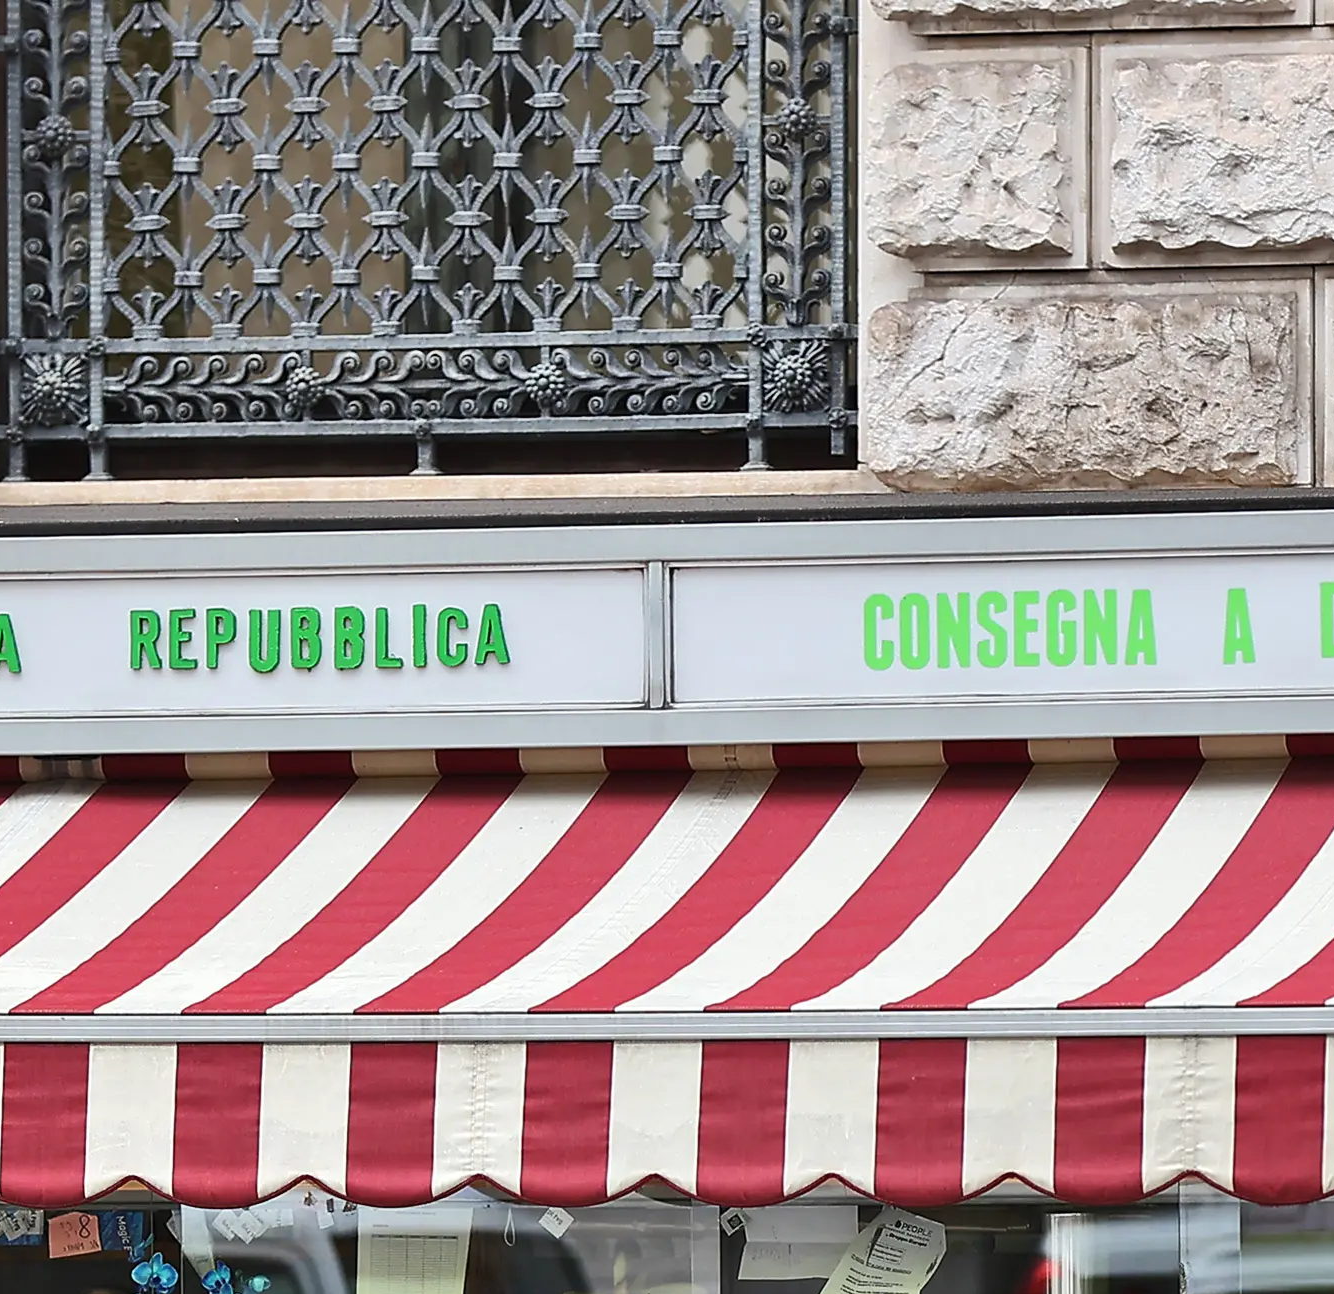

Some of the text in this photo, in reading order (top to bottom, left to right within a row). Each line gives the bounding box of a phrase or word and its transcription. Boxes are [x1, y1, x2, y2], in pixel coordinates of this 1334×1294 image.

[129, 602, 511, 673] REPUBBLICA
[863, 588, 1158, 671] CONSEGNA
[1222, 587, 1256, 665] A
